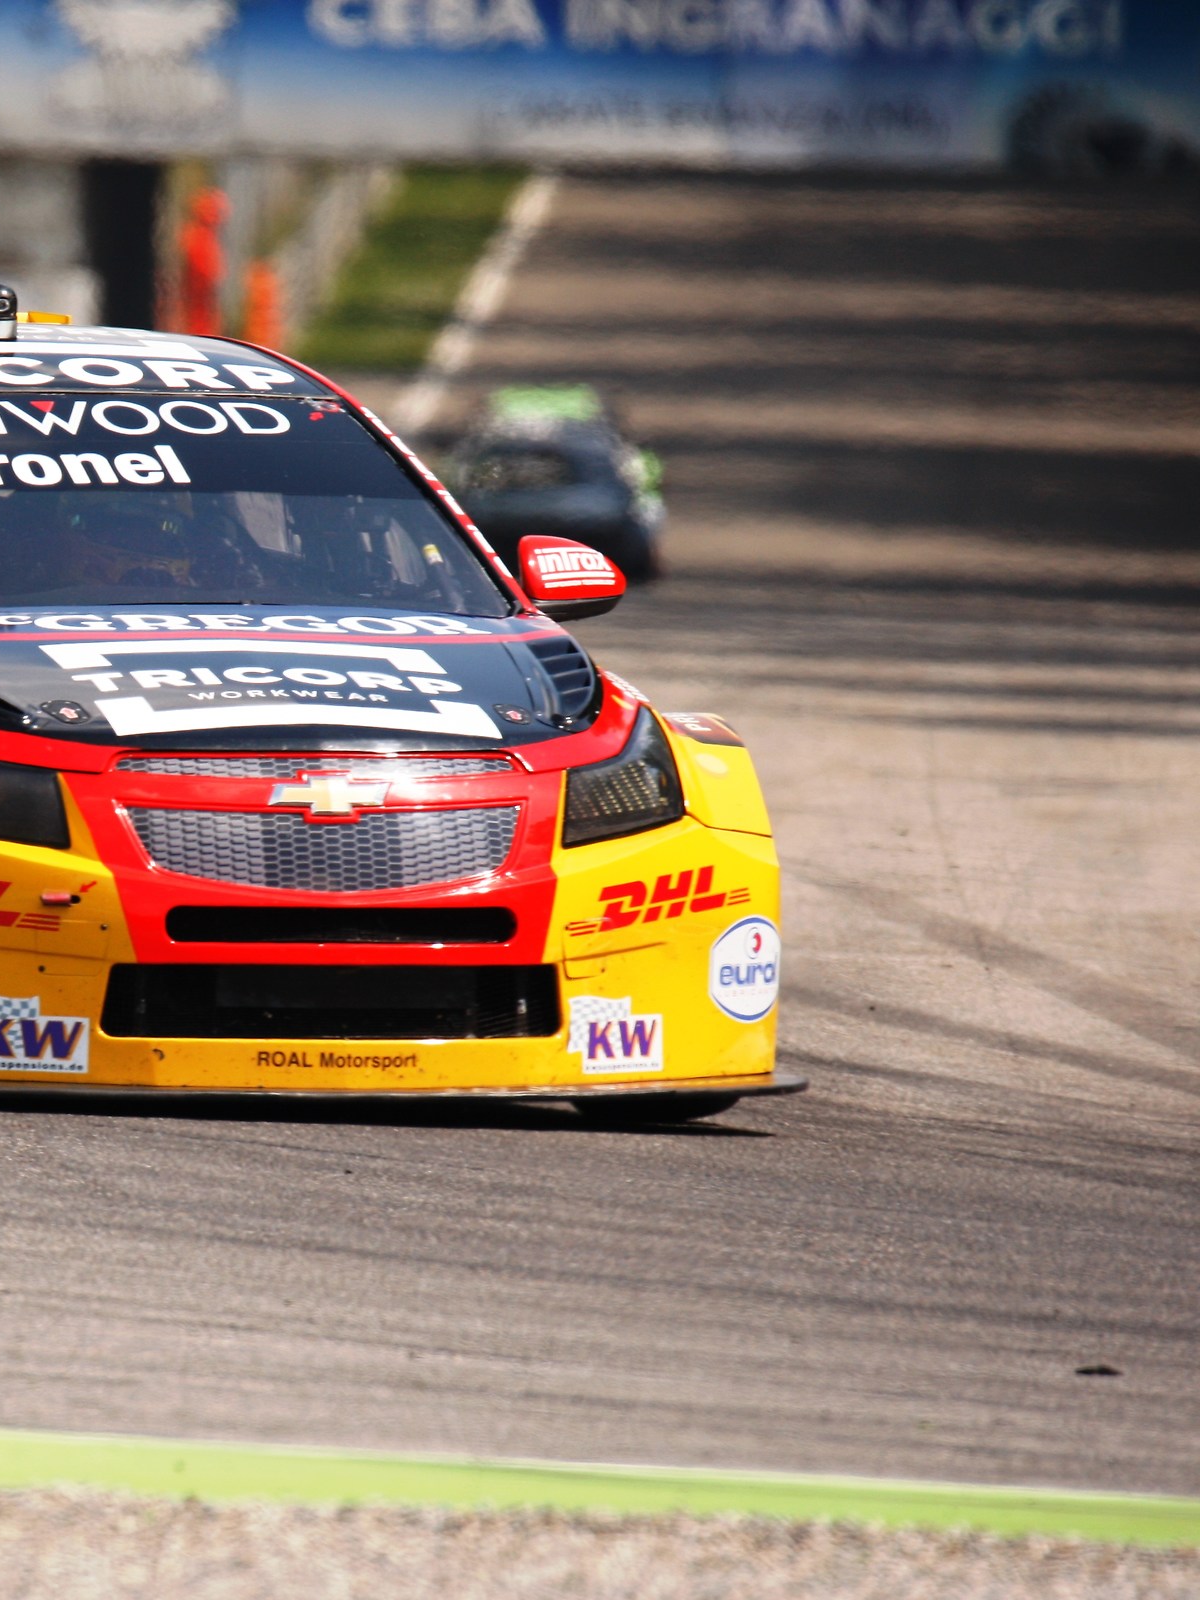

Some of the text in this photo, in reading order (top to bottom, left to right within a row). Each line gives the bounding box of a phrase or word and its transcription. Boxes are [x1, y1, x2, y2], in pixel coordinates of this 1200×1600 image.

[71, 665, 465, 695] TRICORP
[187, 690, 389, 704] WORKWEAR
[598, 865, 728, 932] DHL
[587, 1019, 657, 1060] KW
[257, 1050, 417, 1071] ROAL Motorsport
